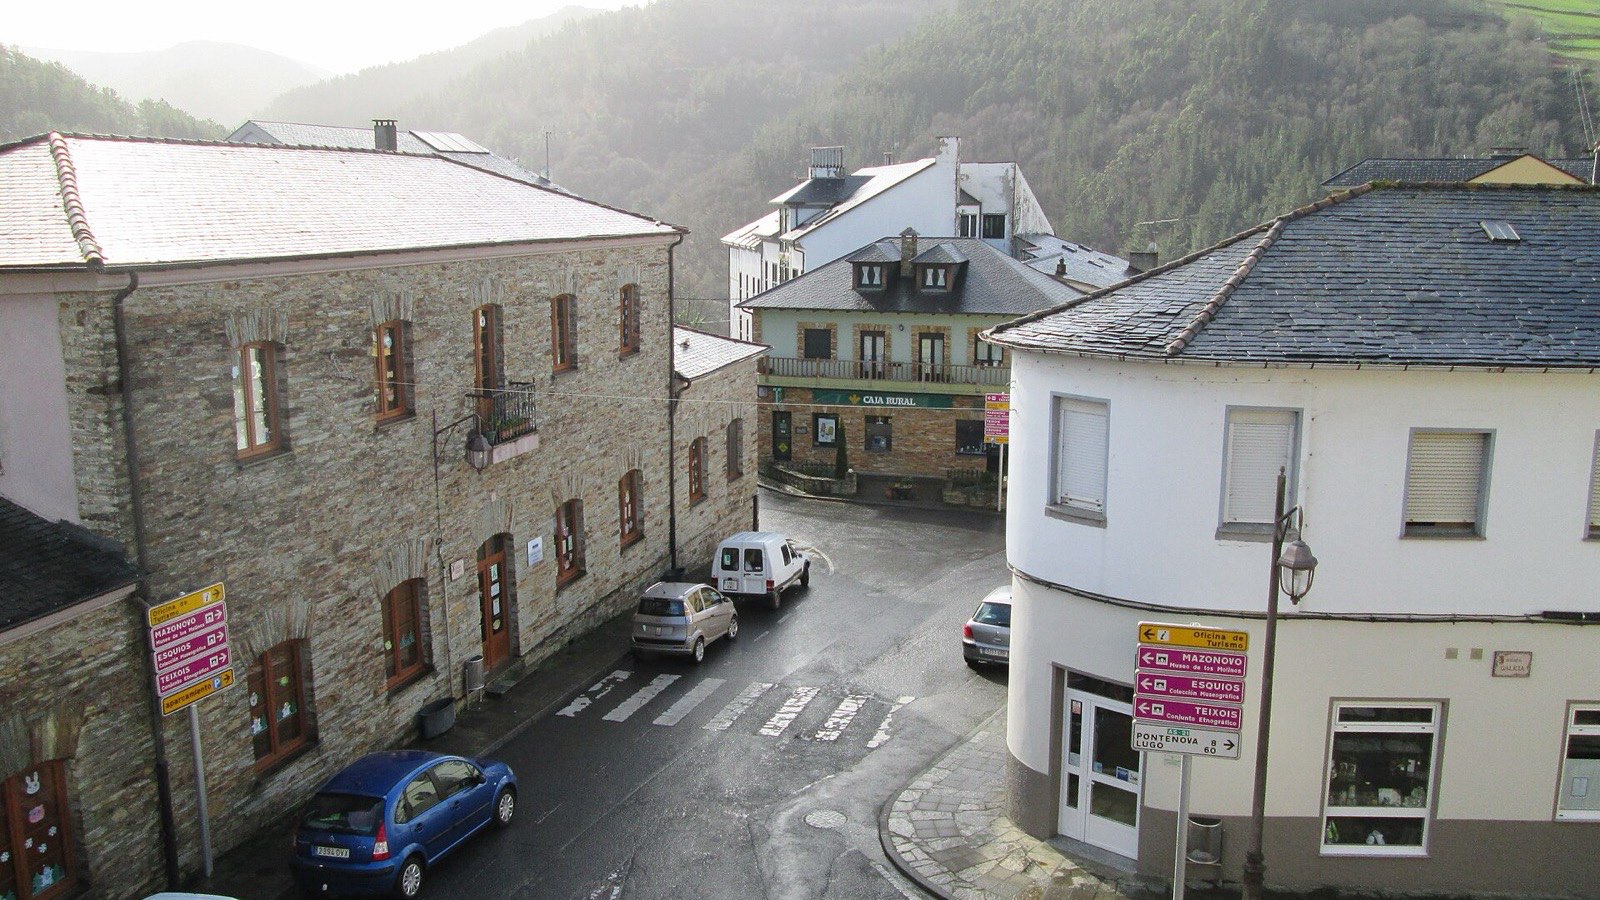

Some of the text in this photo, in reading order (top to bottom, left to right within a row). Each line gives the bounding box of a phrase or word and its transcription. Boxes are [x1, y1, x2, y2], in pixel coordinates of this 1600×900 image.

[863, 396, 916, 406] CAJA RURAL
[153, 605, 176, 616] Oficina
[154, 611, 179, 623] Turismo
[155, 618, 196, 638] MAZONOVO
[156, 636, 171, 645] Museo
[1194, 632, 1226, 640] Oficina
[1207, 640, 1243, 648] Turismo
[158, 642, 191, 662] ESQUIOS
[1182, 654, 1242, 665] MAZONOVO
[160, 666, 190, 684] TEIXOIS
[1192, 681, 1240, 691] ESQUIOS
[166, 683, 212, 708] aparcamiento
[1169, 688, 1197, 696] Colección
[1195, 707, 1238, 718] TEIXOIS
[1166, 713, 1237, 726] Conjunto Etnográfico
[1136, 733, 1198, 744] PONTENOVA
